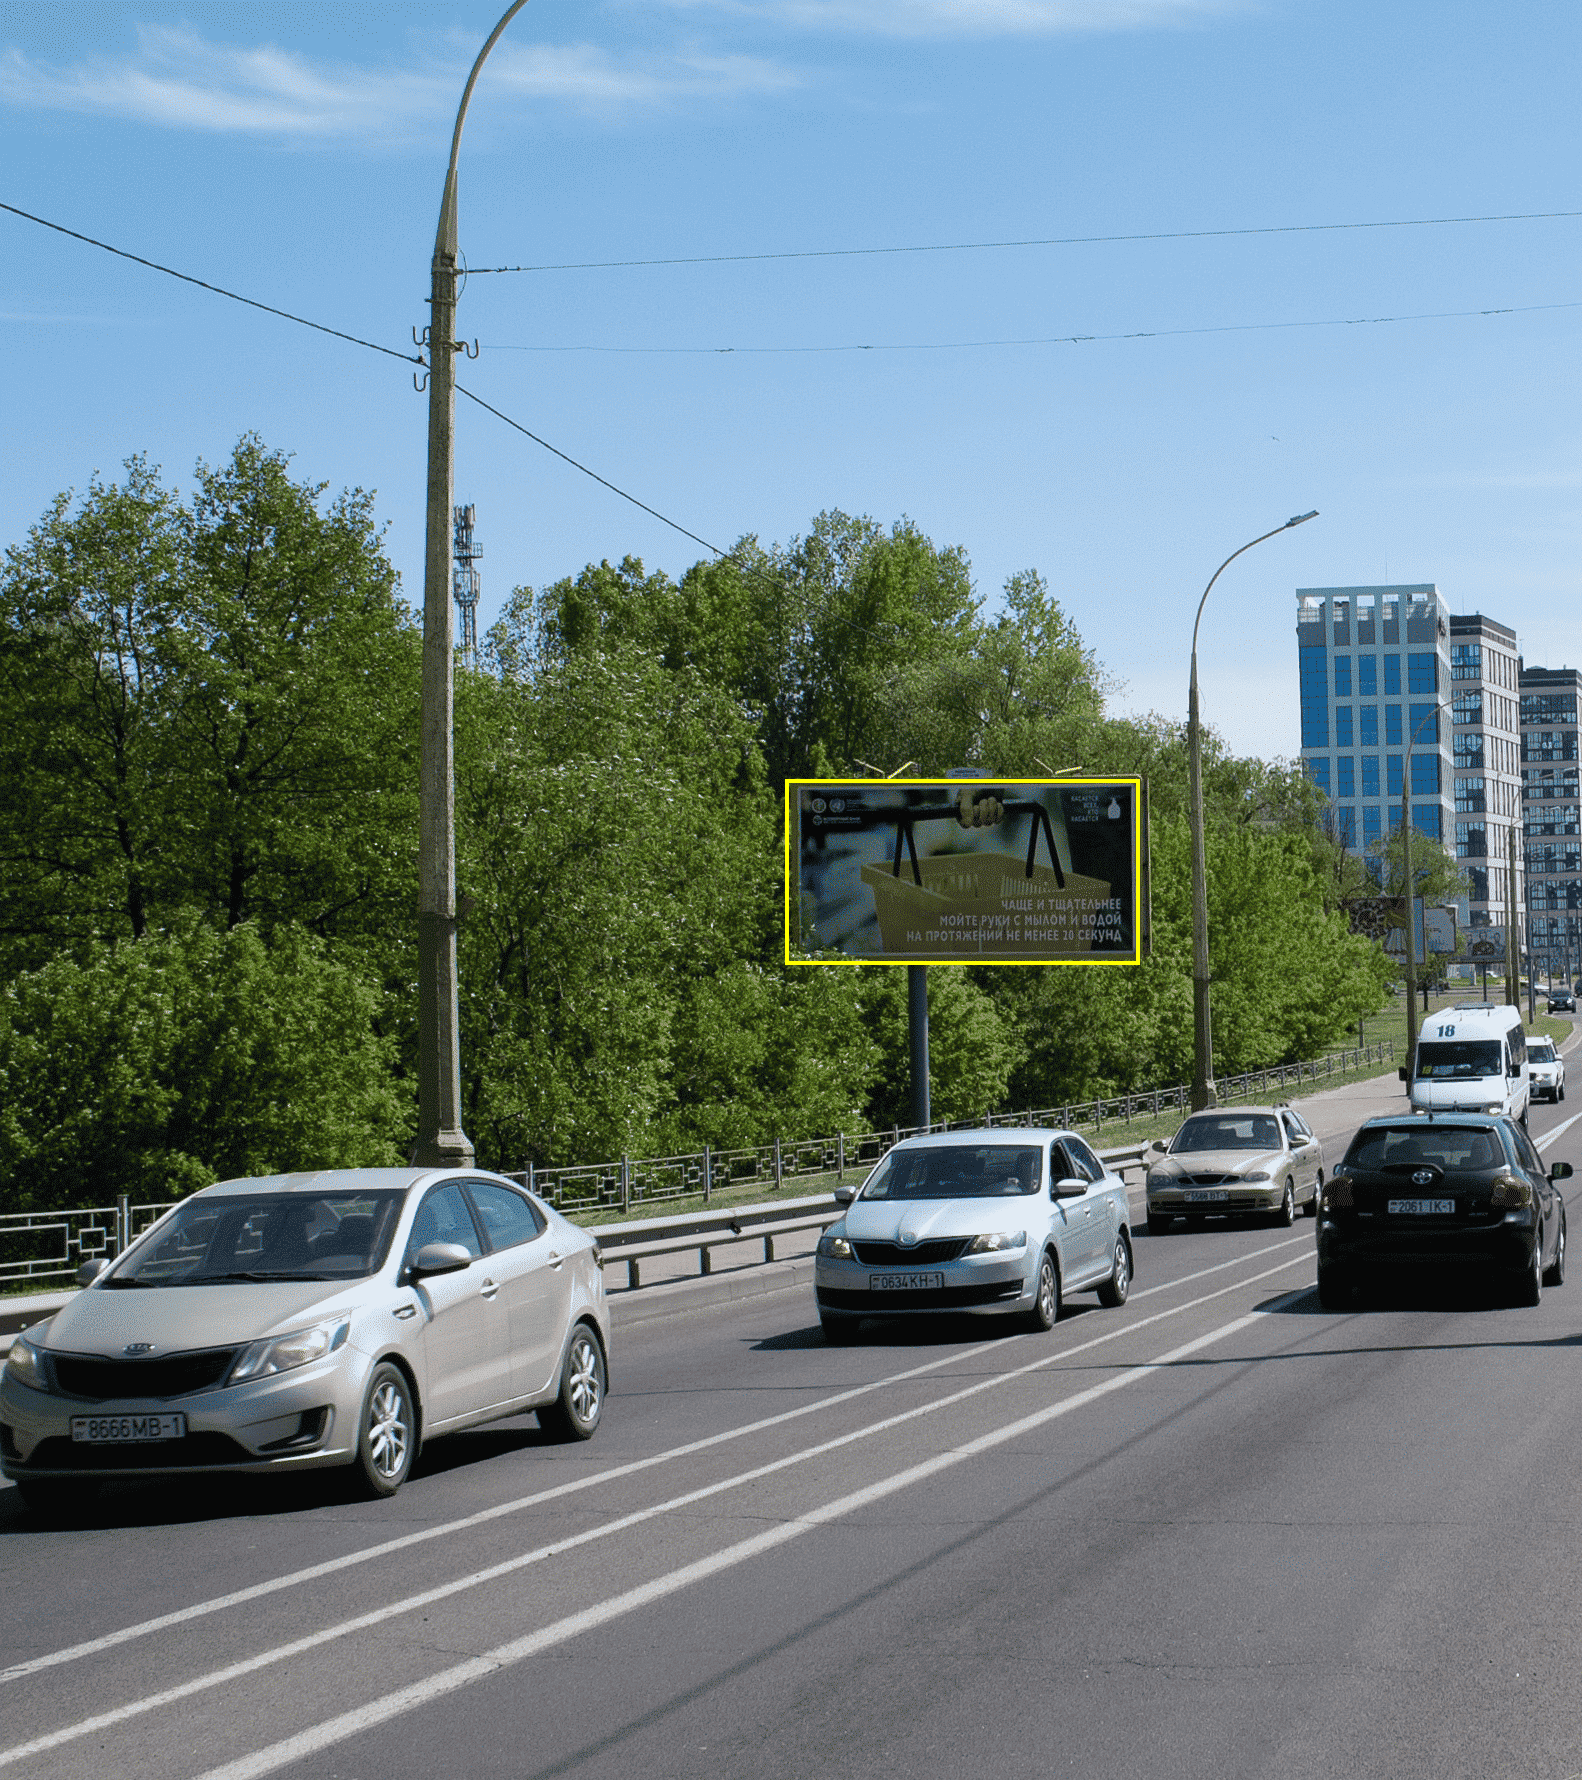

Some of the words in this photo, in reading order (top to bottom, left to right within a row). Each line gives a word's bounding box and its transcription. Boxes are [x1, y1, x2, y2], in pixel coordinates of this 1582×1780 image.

[1001, 898, 1034, 912] ЧАЩЕ
[1036, 899, 1046, 911] И
[1048, 897, 1123, 911] ТЩАТЕЛЬНЕЕ
[939, 912, 979, 926] МОЙТЕ
[981, 913, 1011, 928] РУКИ
[1013, 914, 1021, 926] С
[1024, 913, 1067, 926] МЫЛОМ
[1070, 913, 1079, 926] И
[1082, 910, 1123, 926] ВОДОЙ
[906, 930, 922, 942] НА
[925, 930, 1004, 942] ПРОТЯЖЕНИИ
[1006, 929, 1021, 942] НЕ
[1024, 929, 1060, 942] МЕНЕЕ
[1062, 929, 1075, 941] 20
[1077, 928, 1123, 943] СЕКУНД
[1437, 1024, 1456, 1038] 18
[1398, 1200, 1423, 1213] 2061
